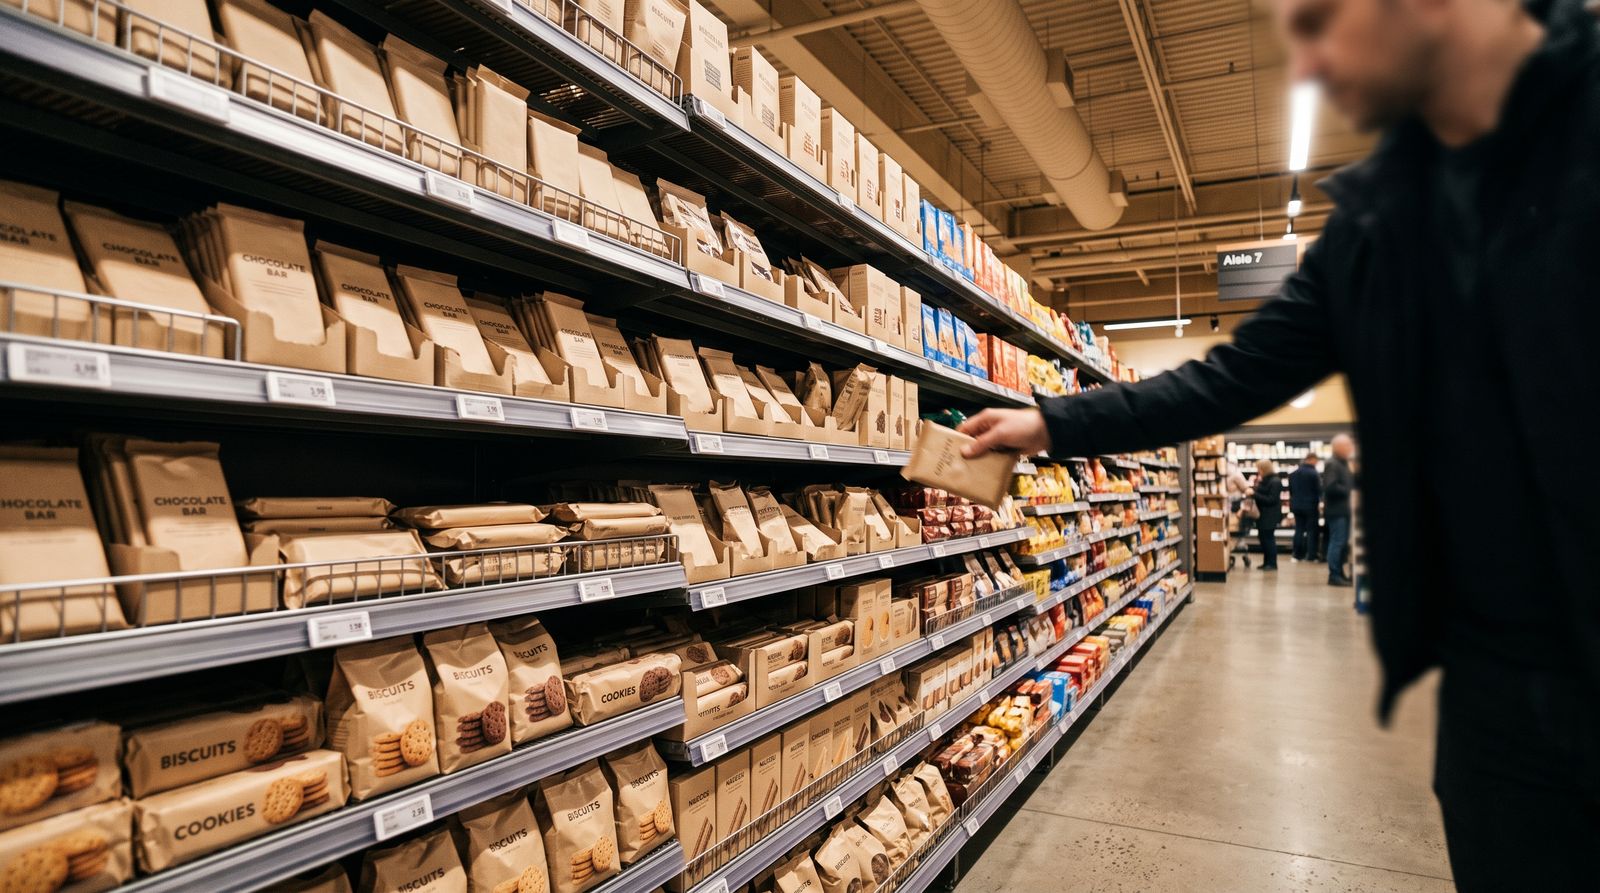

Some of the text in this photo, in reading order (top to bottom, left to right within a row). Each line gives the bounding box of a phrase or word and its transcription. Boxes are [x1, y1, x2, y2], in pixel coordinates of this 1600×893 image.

[242, 253, 306, 273] CHOCOLATE
[1254, 252, 1263, 263] 7
[266, 267, 288, 279] BAR
[341, 282, 391, 301] CHOCOLATE
[361, 294, 379, 304] BAR
[424, 302, 468, 315] CHOCOLATE
[155, 496, 226, 506] CHOCOLATE
[25, 510, 56, 520] BAR
[182, 507, 207, 516] BAR
[453, 664, 493, 680] BISCUITS
[367, 680, 415, 700] BISCUITS
[601, 686, 636, 704] COOKIES
[160, 740, 236, 769] BISCUITS
[630, 769, 659, 788] BISCUITS
[567, 801, 601, 821] BISCUITS
[174, 803, 256, 840] COOKIES
[489, 828, 528, 853] BISCUITS
